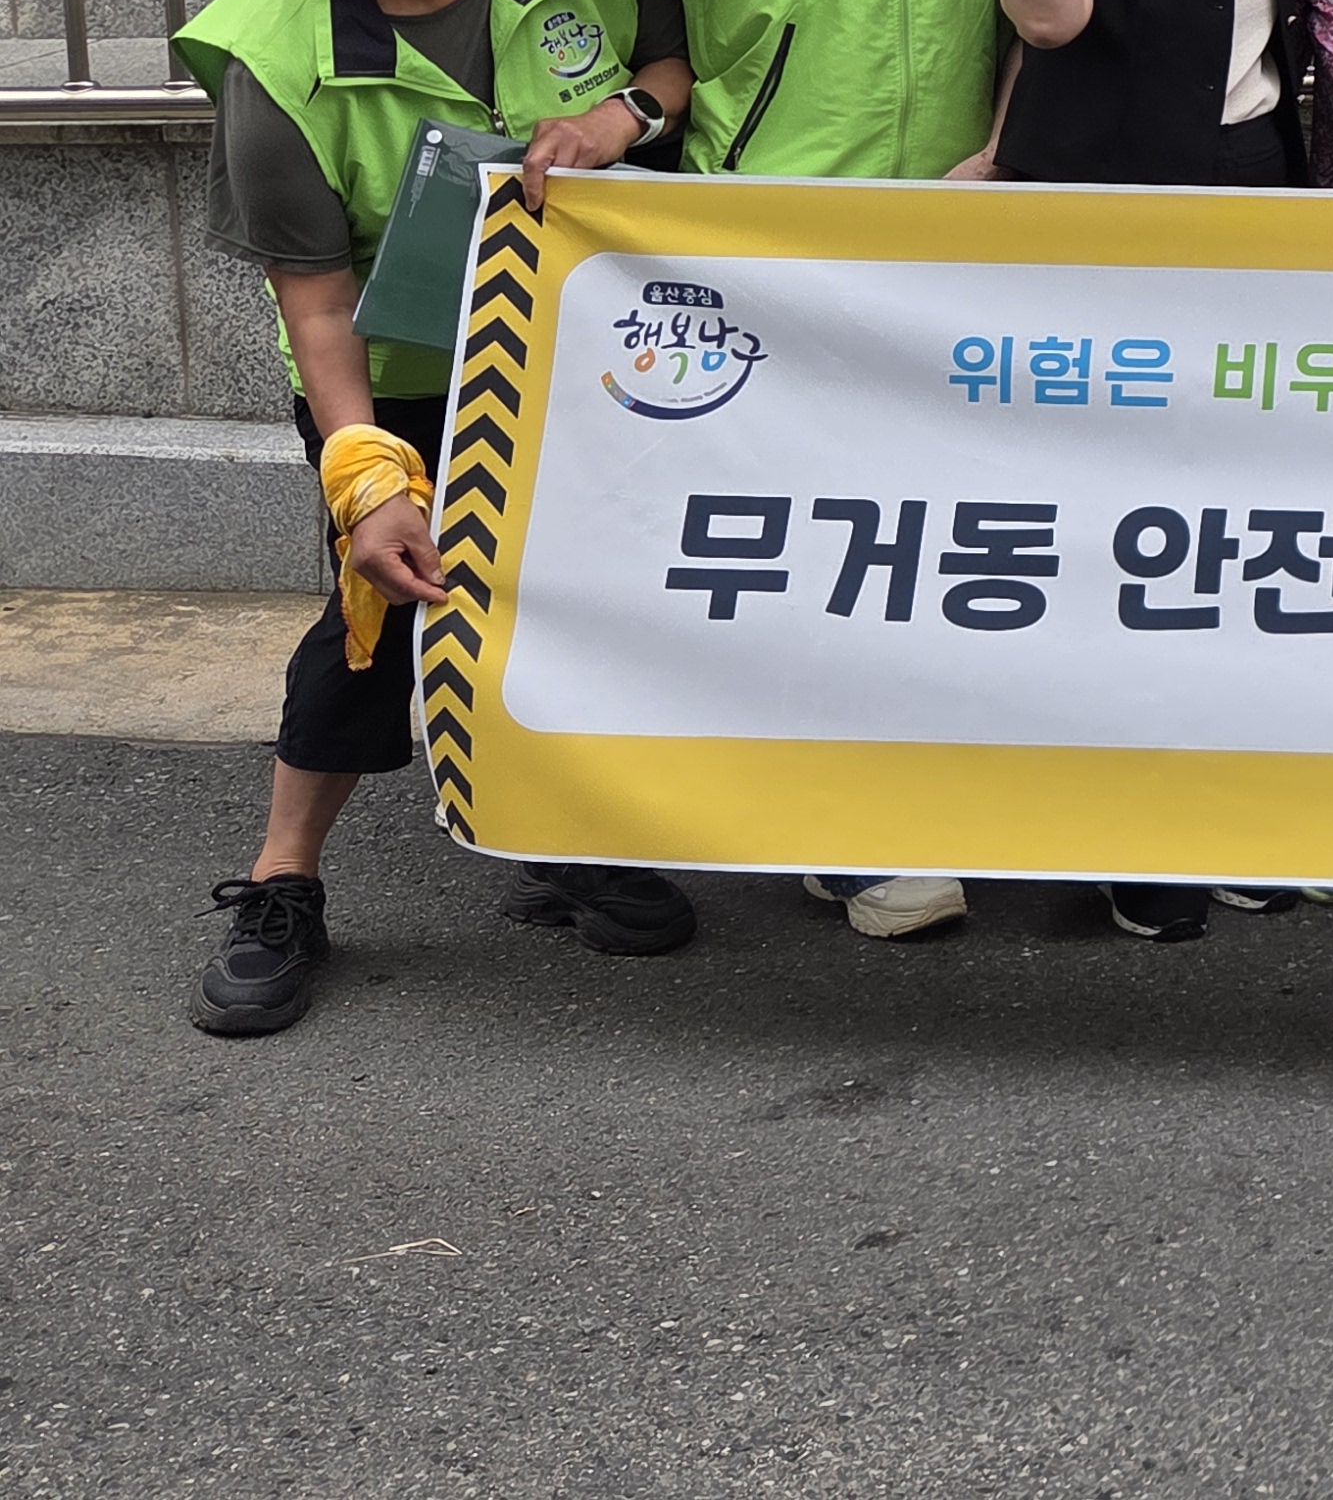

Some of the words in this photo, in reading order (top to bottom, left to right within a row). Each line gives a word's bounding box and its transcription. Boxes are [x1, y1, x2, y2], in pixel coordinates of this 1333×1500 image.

[650, 284, 713, 306] 울산중심
[612, 309, 769, 388] 행복남구
[948, 336, 1174, 408] 위험은
[665, 494, 1060, 631] 무거동
